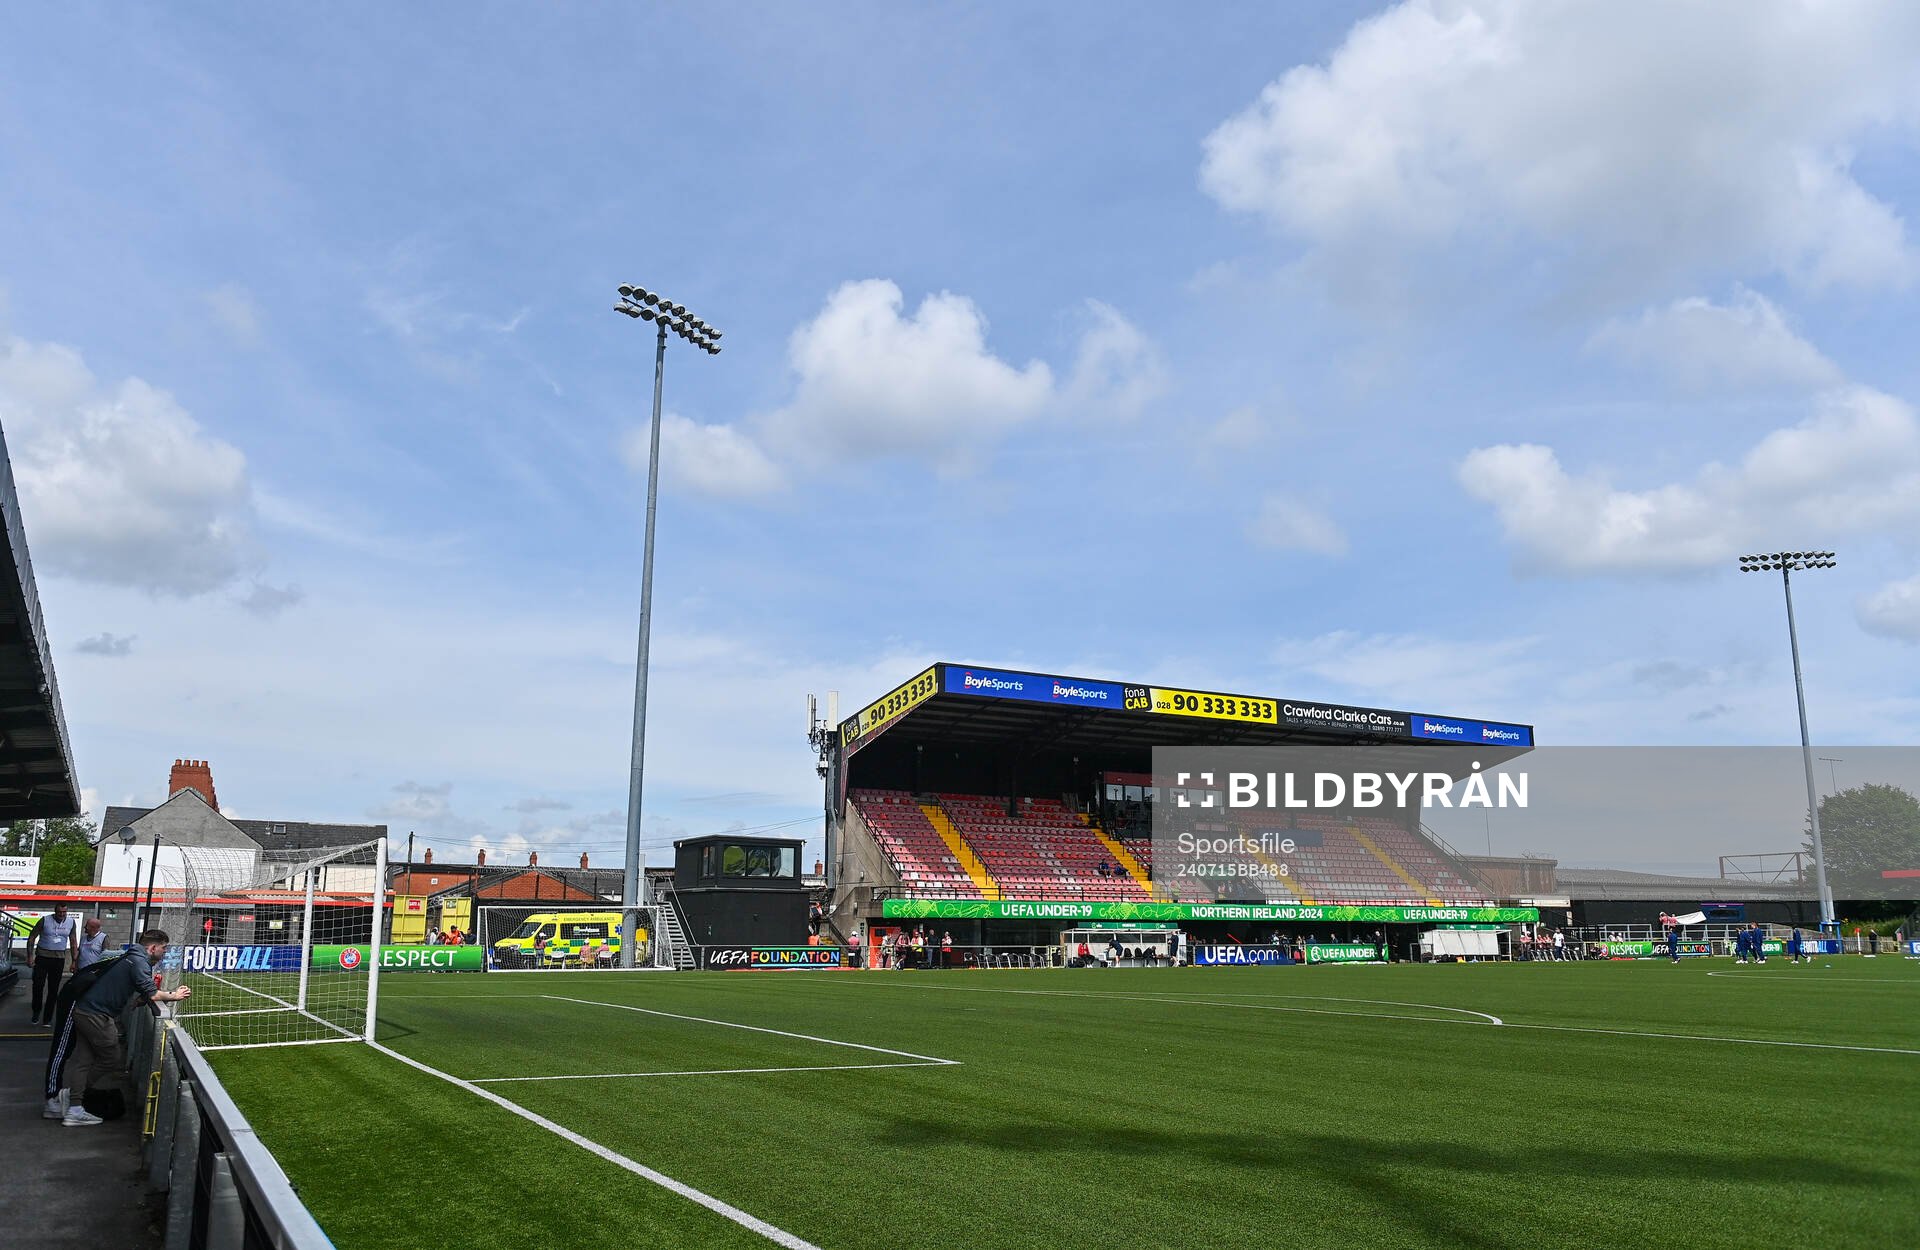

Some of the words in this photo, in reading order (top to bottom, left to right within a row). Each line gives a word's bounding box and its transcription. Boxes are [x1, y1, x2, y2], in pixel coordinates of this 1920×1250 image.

[964, 674, 1024, 691] BoyleSports
[1053, 684, 1108, 700] BoyleSports
[1125, 688, 1145, 698] fona
[871, 704, 885, 725] 90
[887, 689, 909, 715] 333
[911, 675, 934, 701] 333
[1125, 698, 1148, 710] CAB
[1156, 701, 1171, 709] 028
[1173, 694, 1198, 711] 90
[1203, 697, 1236, 716] 333
[1240, 700, 1272, 719] 333
[1283, 704, 1332, 720] Crawford
[1333, 709, 1368, 723] Clarke
[846, 726, 859, 742] CAB
[1424, 722, 1463, 735] BoyleSports
[1482, 728, 1520, 740] BoyleSports
[1002, 904, 1034, 916] UEFA
[1036, 905, 1093, 917] UNDER-19
[1191, 907, 1250, 917] NORTHERN
[1252, 908, 1296, 918] IRELAND
[1299, 908, 1323, 918] 2024
[1404, 911, 1427, 919] UEFA
[1429, 911, 1467, 919] UNDER-19
[1204, 946, 1279, 964] UEFA.com
[1322, 948, 1345, 958] UEFA
[1348, 948, 1385, 958] UNDER-
[1610, 944, 1643, 955] RESPECT
[1675, 945, 1710, 954] UNDATION
[379, 950, 458, 967] ESPECT
[710, 950, 749, 964] UEFA
[751, 951, 840, 963] FOUNDATION
